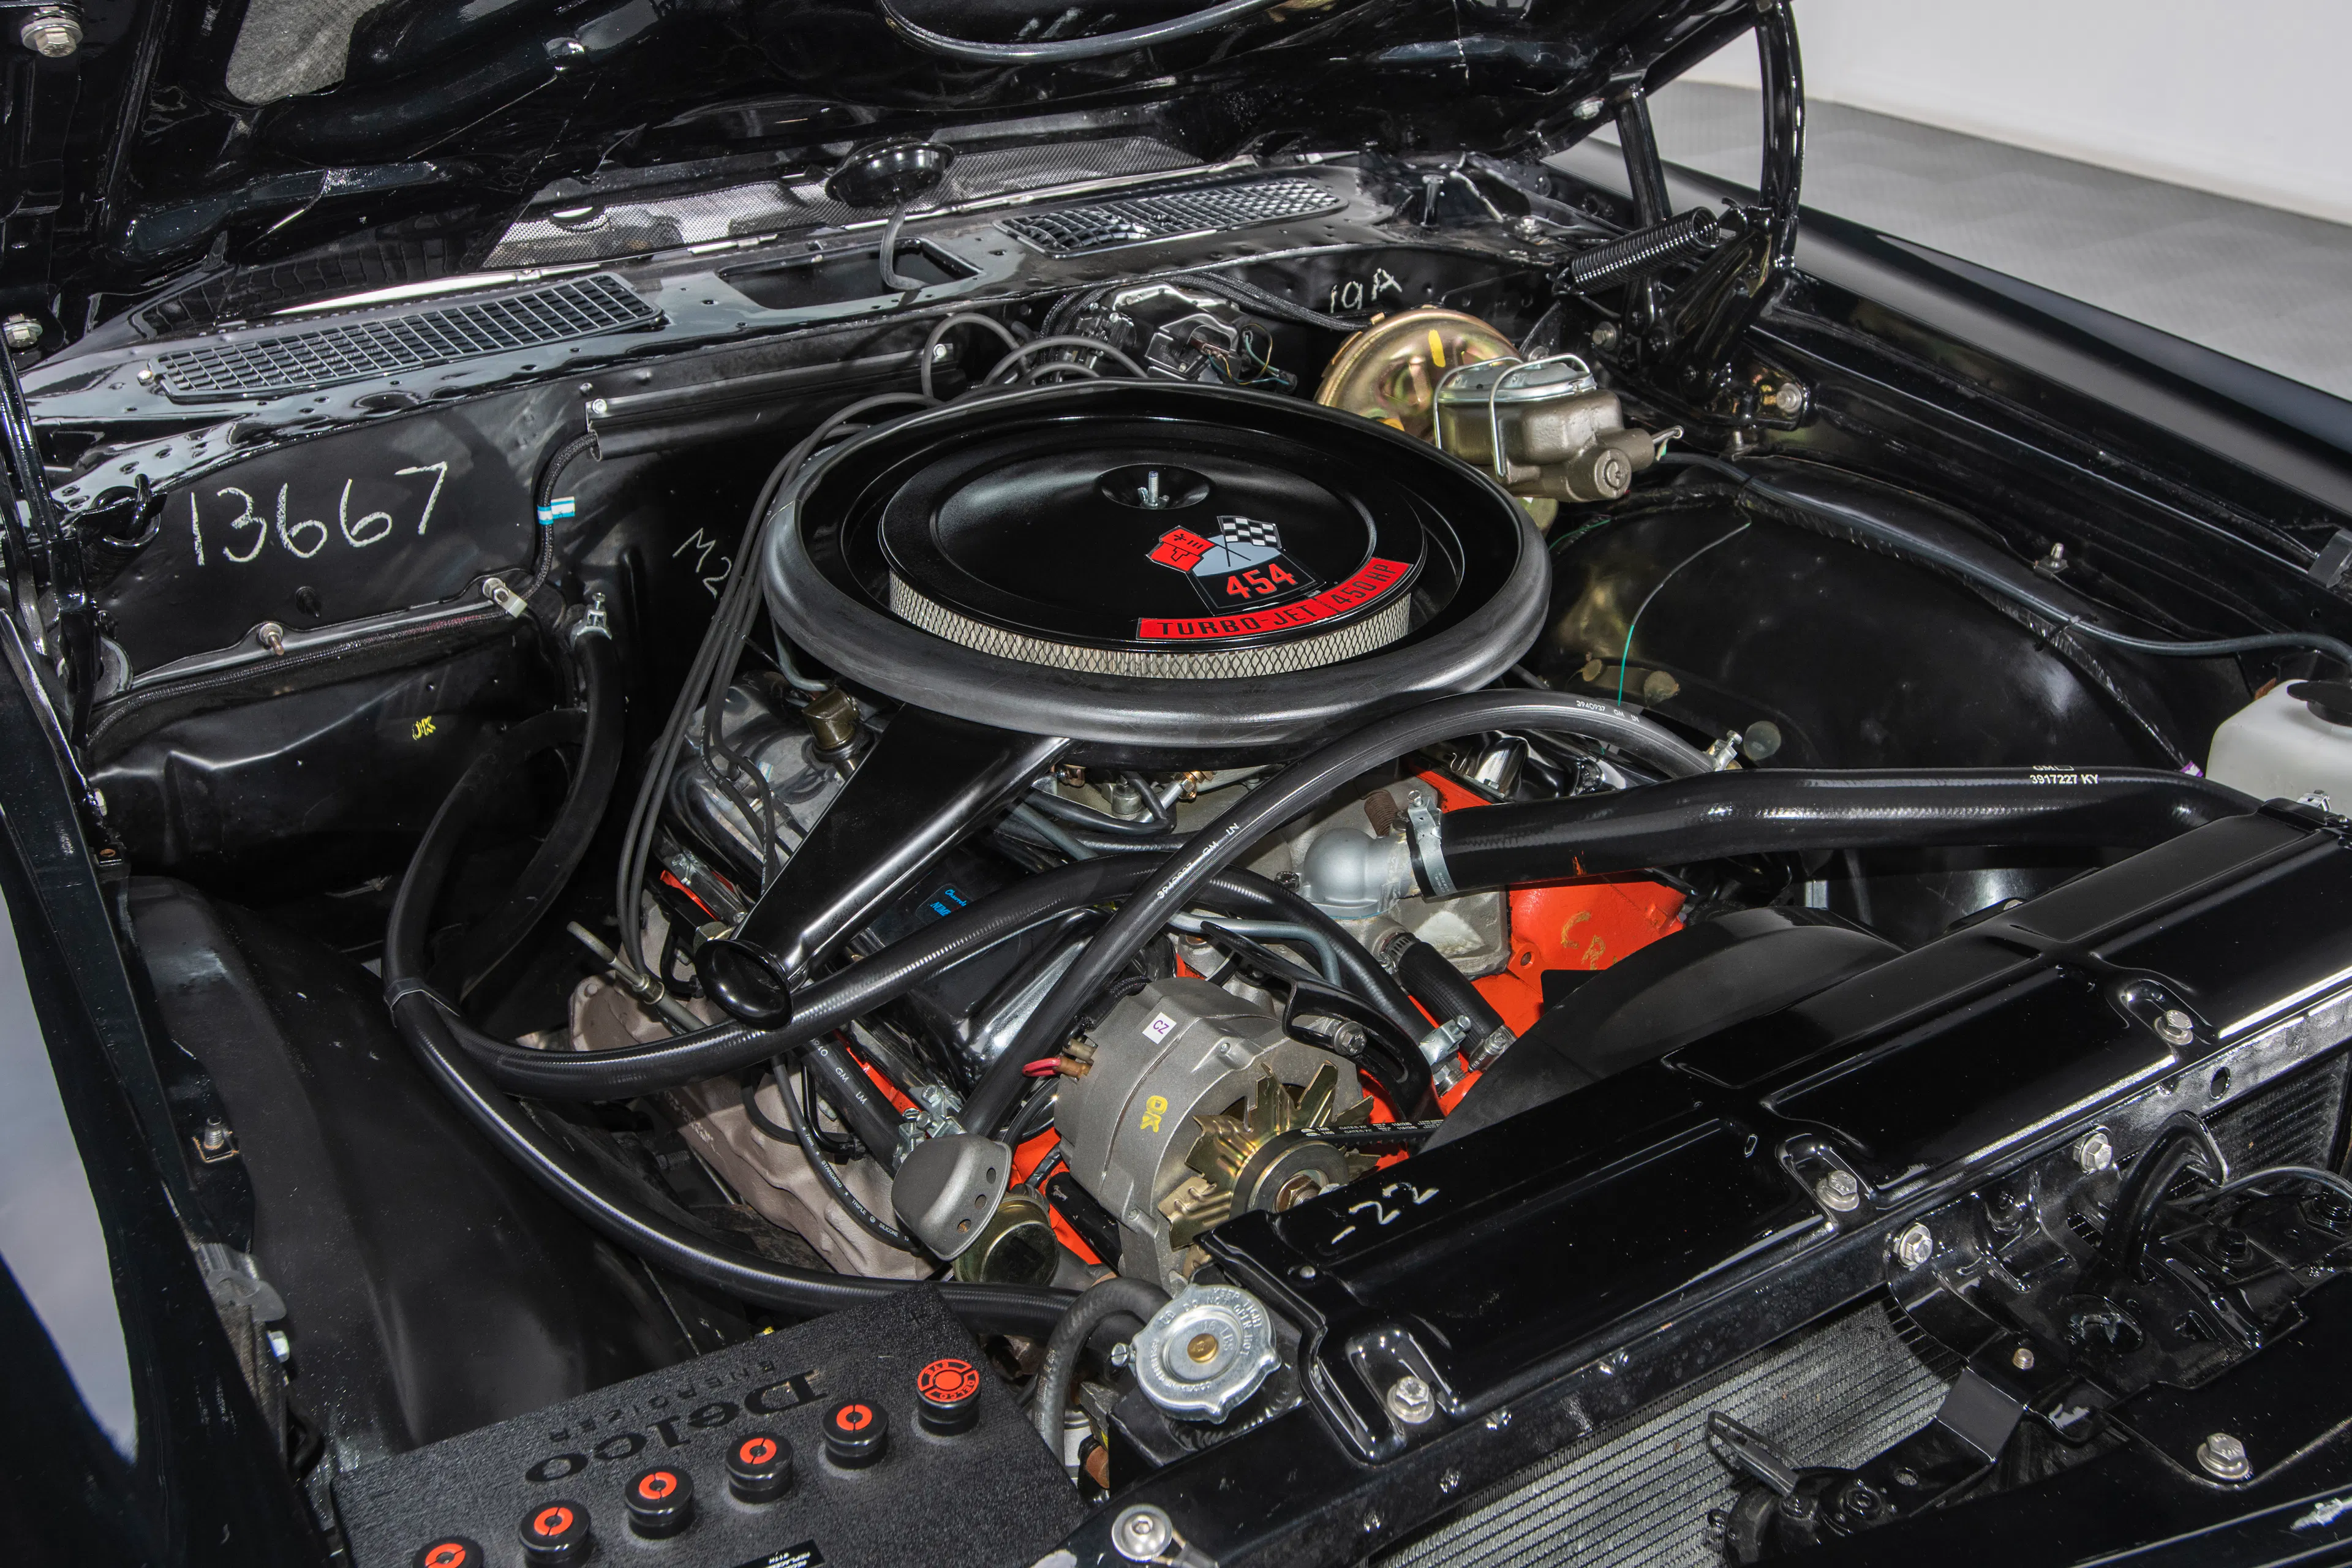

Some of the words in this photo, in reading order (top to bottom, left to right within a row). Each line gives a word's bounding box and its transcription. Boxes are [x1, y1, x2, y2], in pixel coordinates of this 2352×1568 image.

[190, 461, 448, 567] 13667
[1226, 563, 1298, 600] 454
[1157, 604, 1317, 636] TURBO-JET
[1330, 580, 1377, 606] 450
[1371, 563, 1398, 583] HP
[1576, 700, 1605, 712] 3940937
[1613, 709, 1625, 718] GM
[2029, 773, 2078, 785] 3917227
[2080, 773, 2099, 785] KY
[1202, 841, 1220, 856] GM
[1153, 1019, 1170, 1035] CZ
[835, 1067, 850, 1084] GM
[855, 1091, 868, 1105] LM
[1140, 1095, 1169, 1133] OK
[805, 1132, 815, 1147] 7mm
[821, 1160, 843, 1188] STANDARD
[851, 1199, 867, 1216] TRIPLE
[878, 1223, 899, 1237] SILICONE
[1183, 1298, 1199, 1313] DO
[1213, 1287, 1241, 1300] KEEP
[1219, 1327, 1234, 1352] LBS
[550, 1359, 776, 1443] ENERGIZER
[939, 1379, 976, 1400] DELCO
[525, 1369, 828, 1482] Delco
